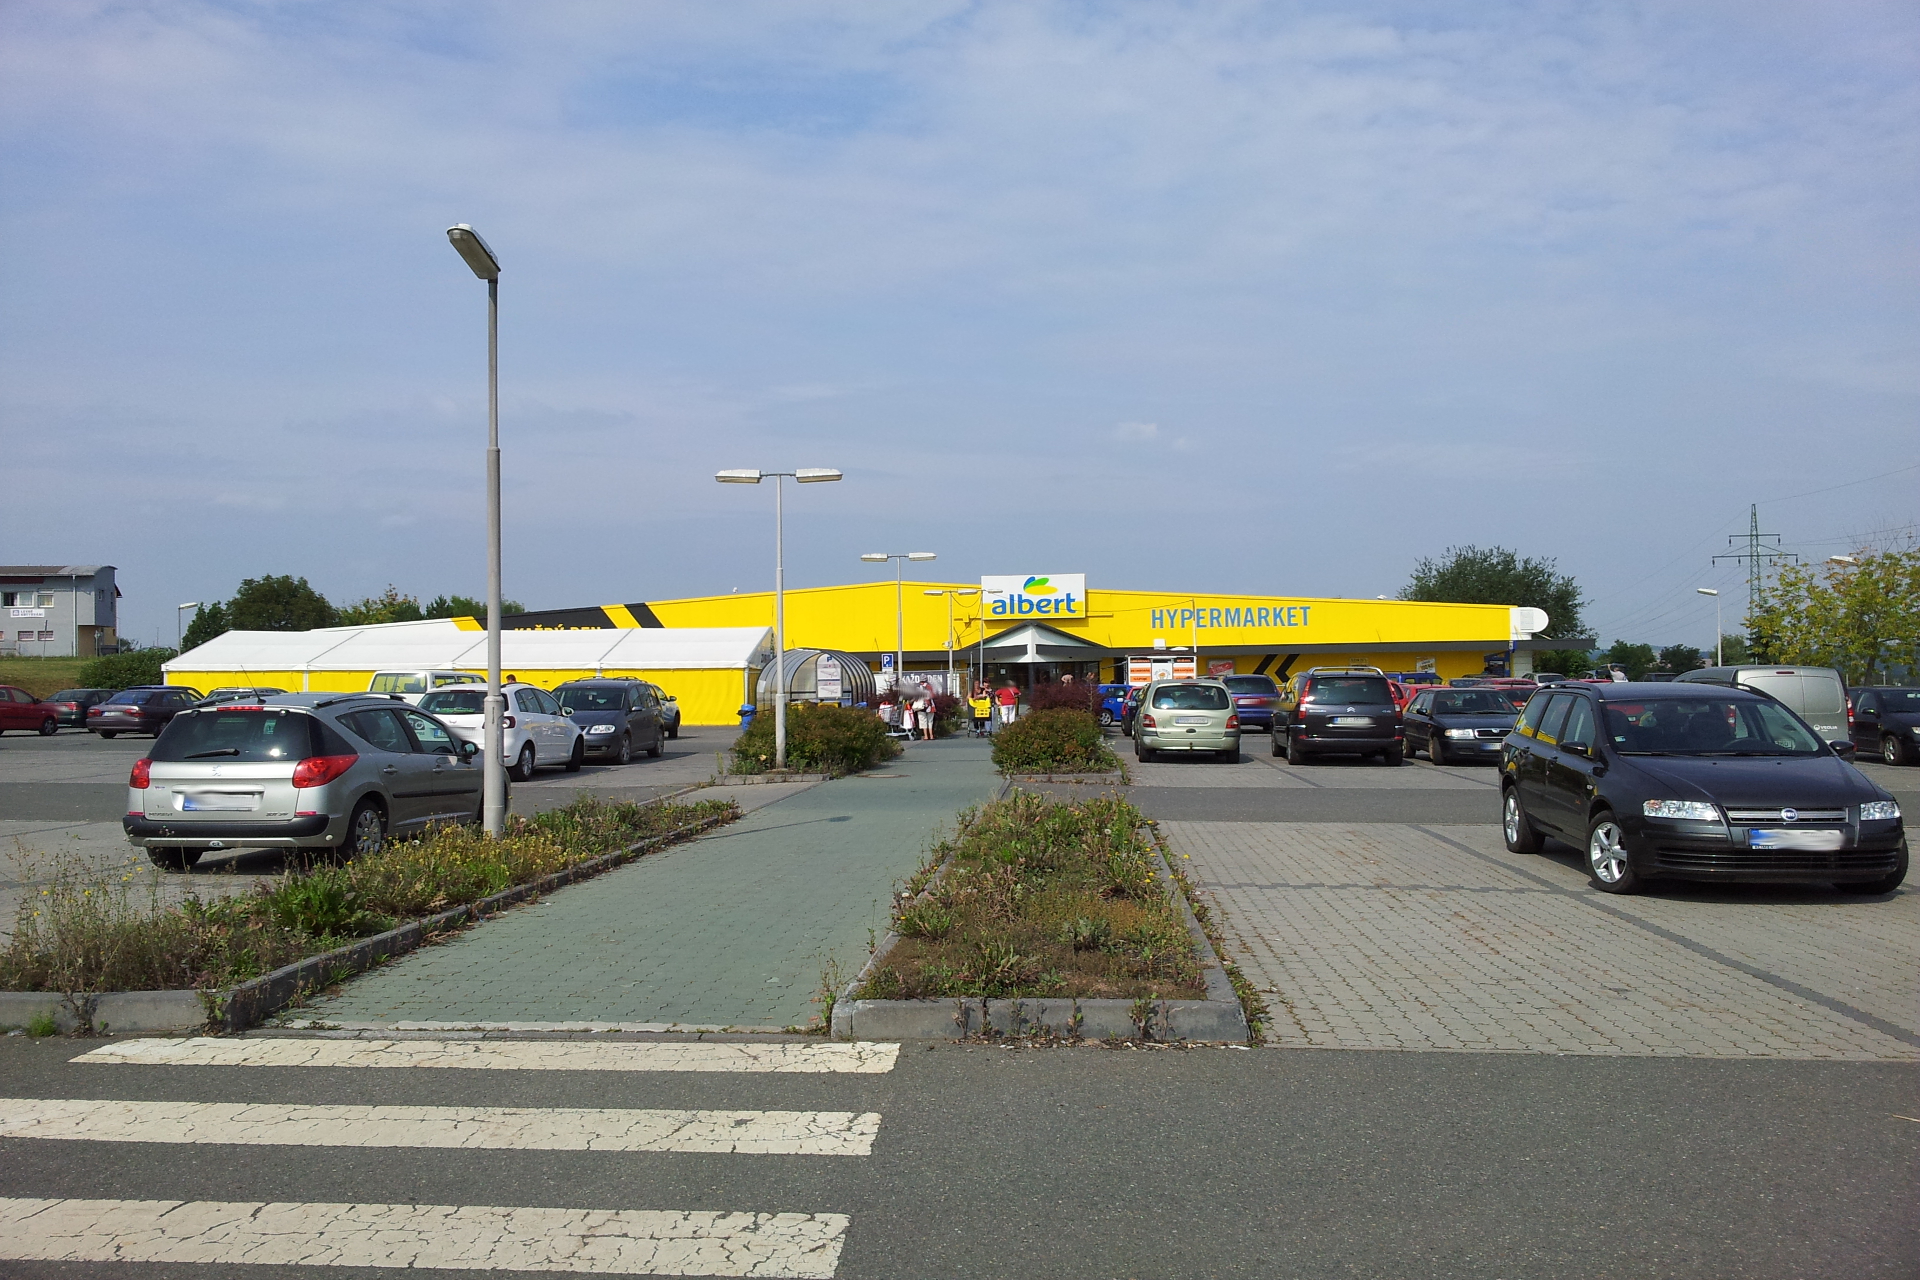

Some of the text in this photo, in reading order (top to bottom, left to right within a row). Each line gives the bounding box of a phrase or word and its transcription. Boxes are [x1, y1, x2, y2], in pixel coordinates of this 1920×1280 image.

[991, 592, 1076, 615] albert
[1150, 606, 1311, 629] HYPERMARKET
[884, 656, 890, 665] P
[901, 673, 926, 684] KAŽD
